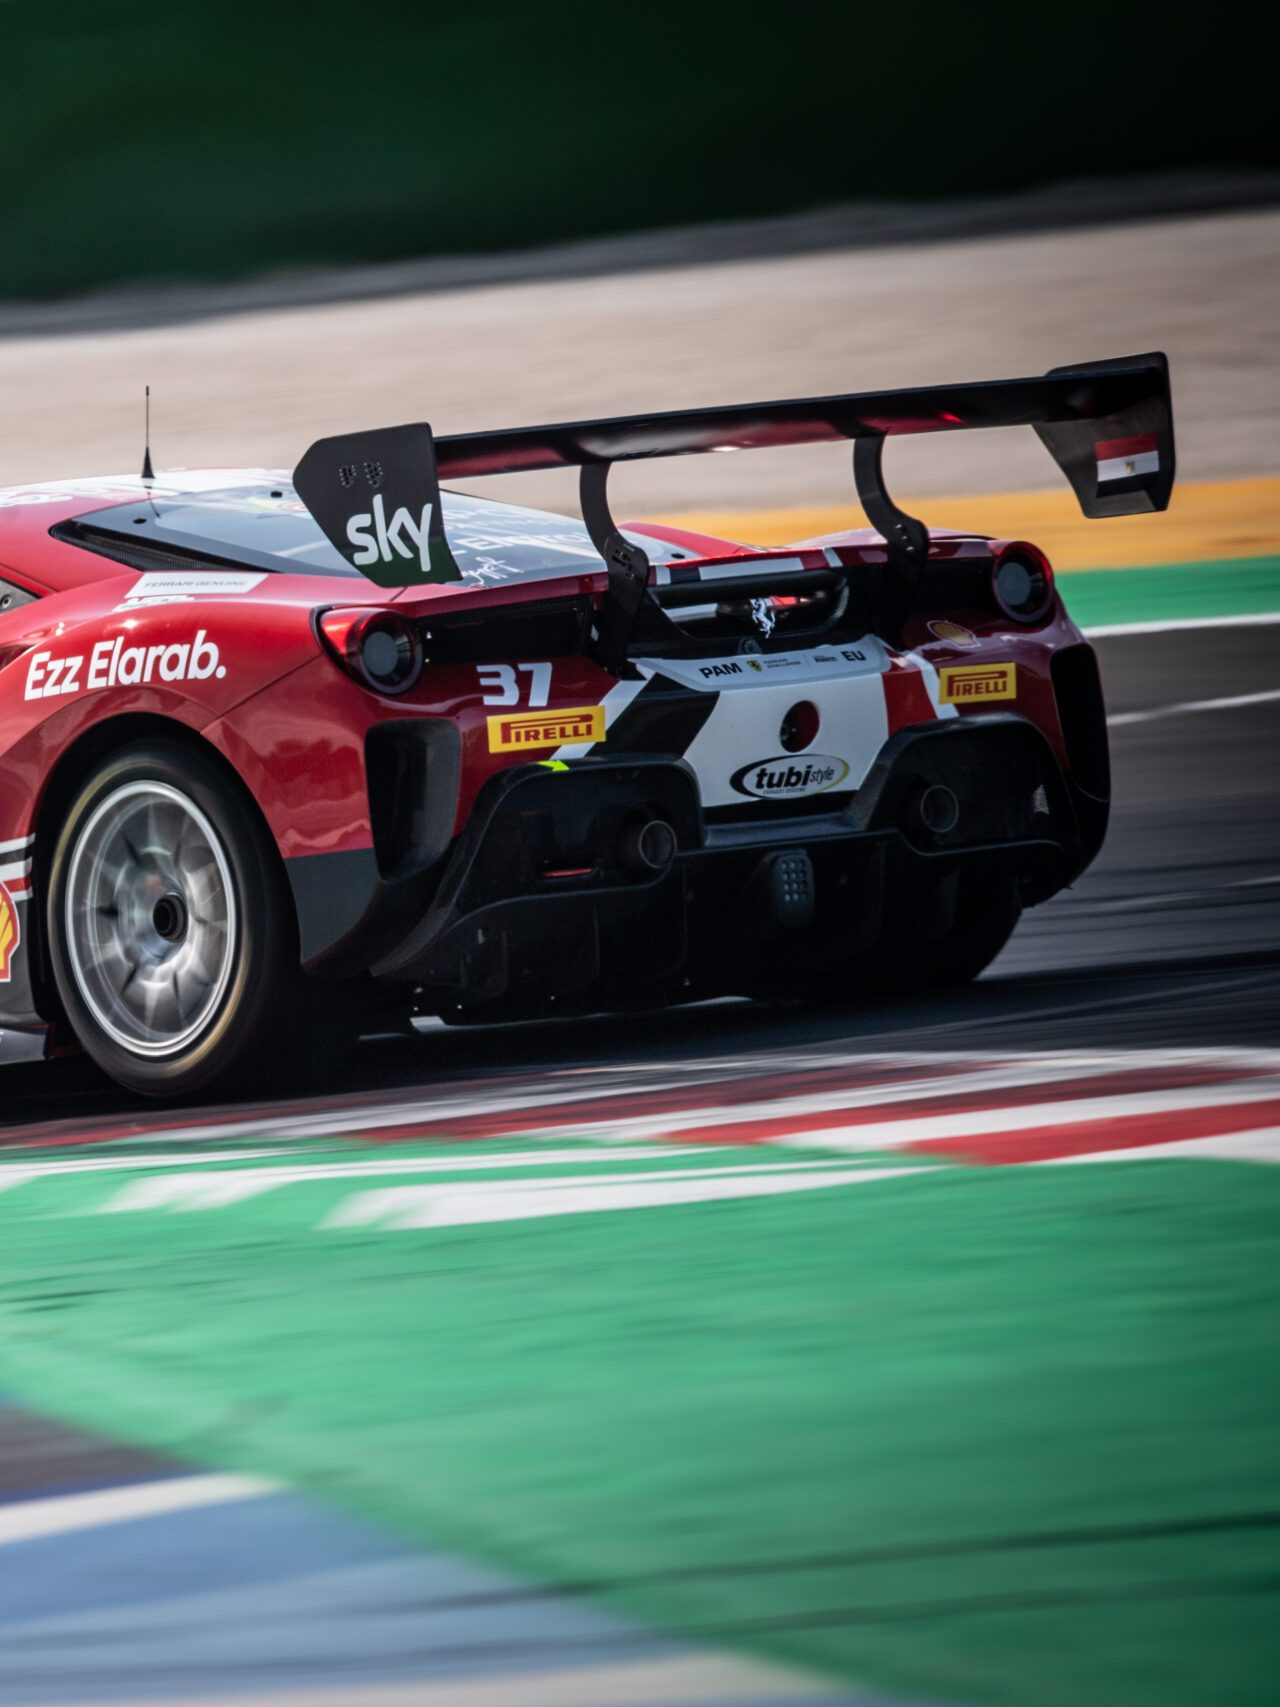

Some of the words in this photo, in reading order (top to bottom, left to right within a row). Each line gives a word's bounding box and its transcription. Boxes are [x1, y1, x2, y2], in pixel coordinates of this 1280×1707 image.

[346, 494, 433, 572] sky
[24, 651, 84, 701] Ezz
[87, 629, 226, 689] Elarab.
[699, 663, 743, 679] PAM
[840, 650, 867, 662] EU
[476, 662, 553, 707] 37
[947, 670, 1008, 697] PIRELLI
[501, 714, 593, 744] PIRELLI
[755, 765, 813, 789] tubi
